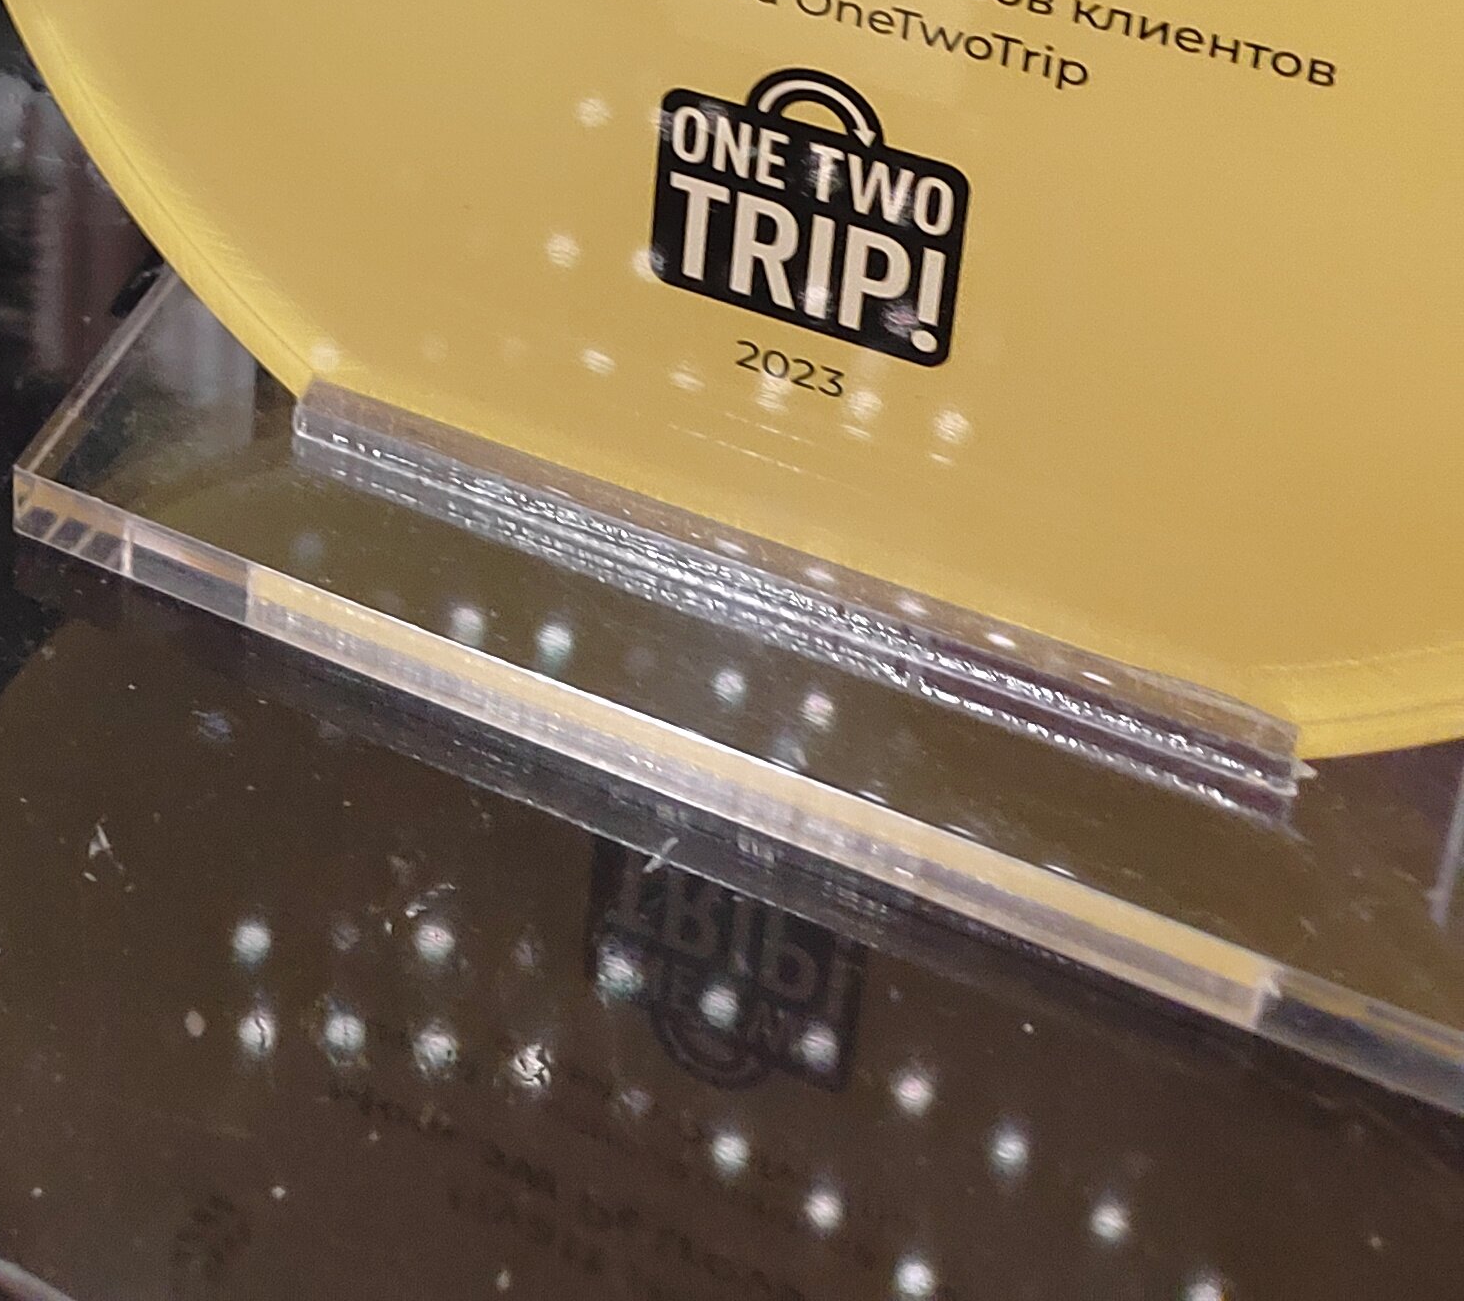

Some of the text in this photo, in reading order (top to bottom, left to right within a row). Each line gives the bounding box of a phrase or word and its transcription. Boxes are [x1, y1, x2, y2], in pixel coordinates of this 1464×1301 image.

[671, 105, 955, 237] ONE TWO
[669, 170, 947, 354] TRIP!
[734, 338, 846, 398] 2023
